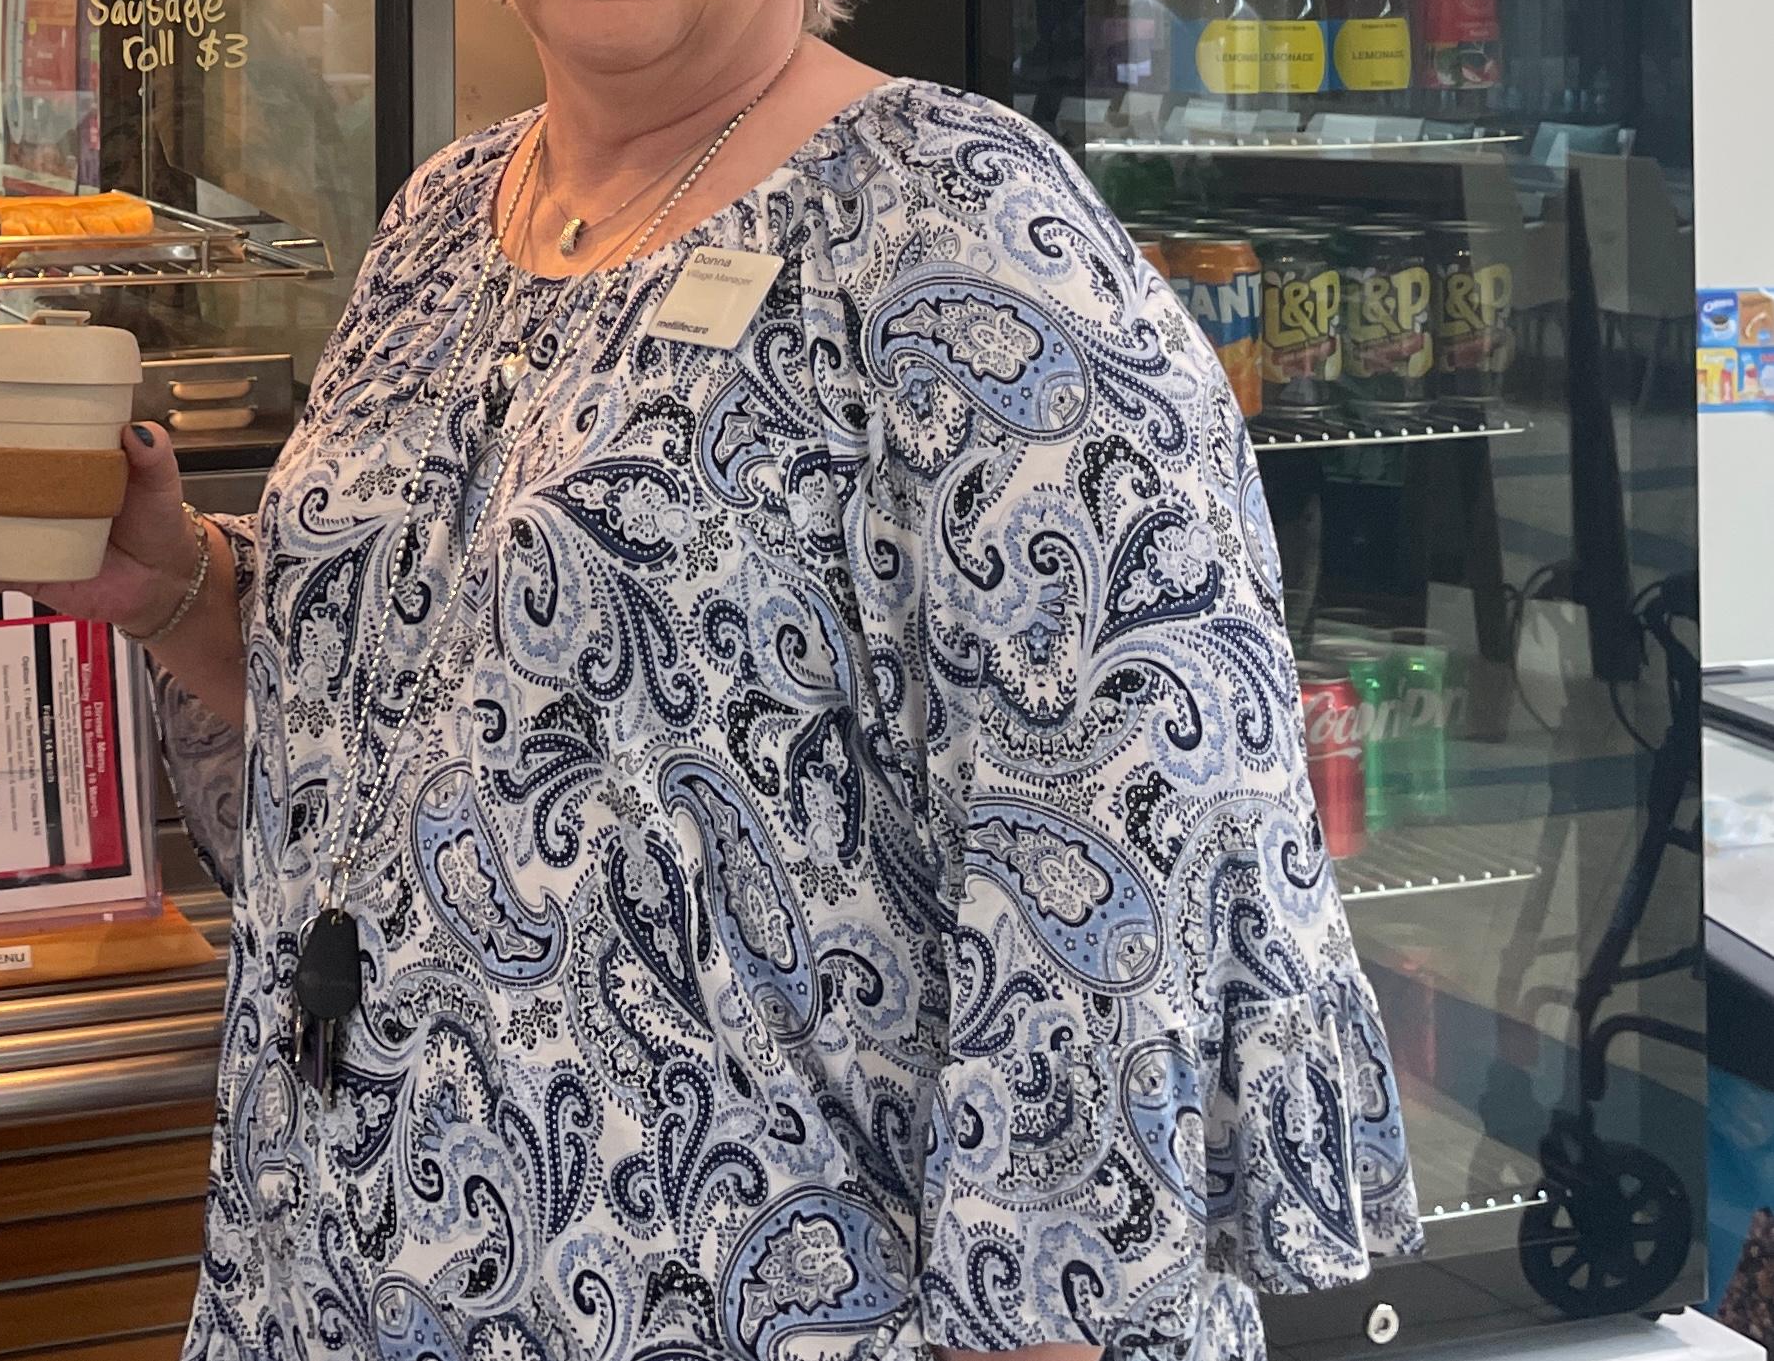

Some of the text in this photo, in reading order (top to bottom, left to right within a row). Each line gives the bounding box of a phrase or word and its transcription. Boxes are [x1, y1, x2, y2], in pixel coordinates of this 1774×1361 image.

[122, 34, 249, 73] roll $3
[694, 253, 732, 268] Donna
